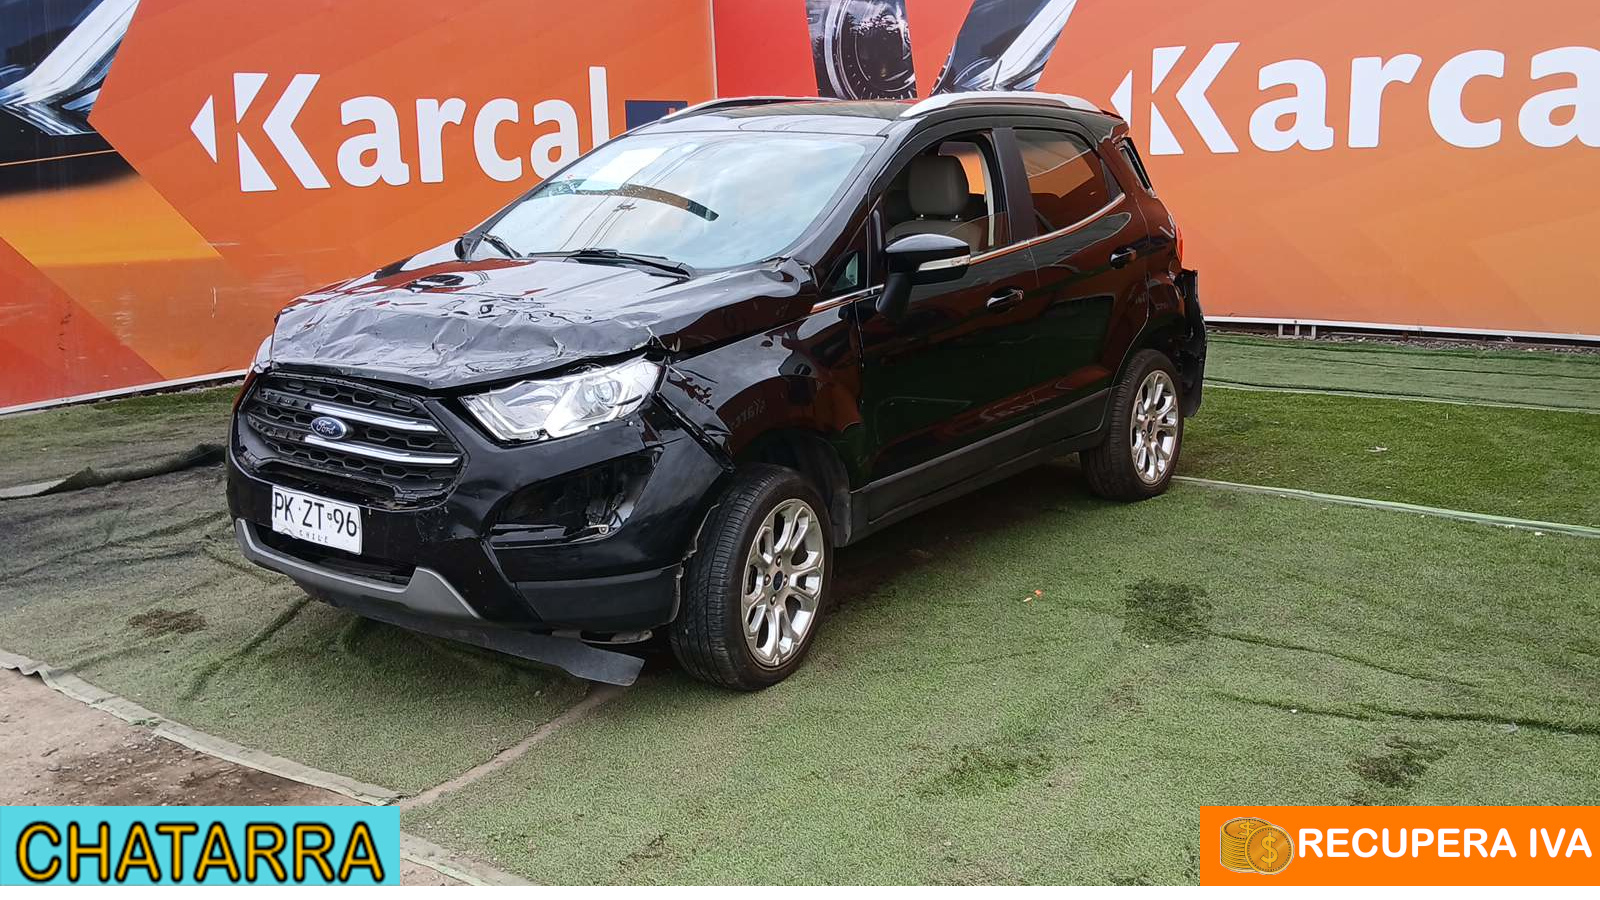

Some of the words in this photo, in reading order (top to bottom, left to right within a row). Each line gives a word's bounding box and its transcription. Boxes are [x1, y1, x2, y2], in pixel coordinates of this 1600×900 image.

[233, 66, 610, 193] Karcal
[316, 419, 336, 435] Ford
[299, 529, 328, 544] CHILE
